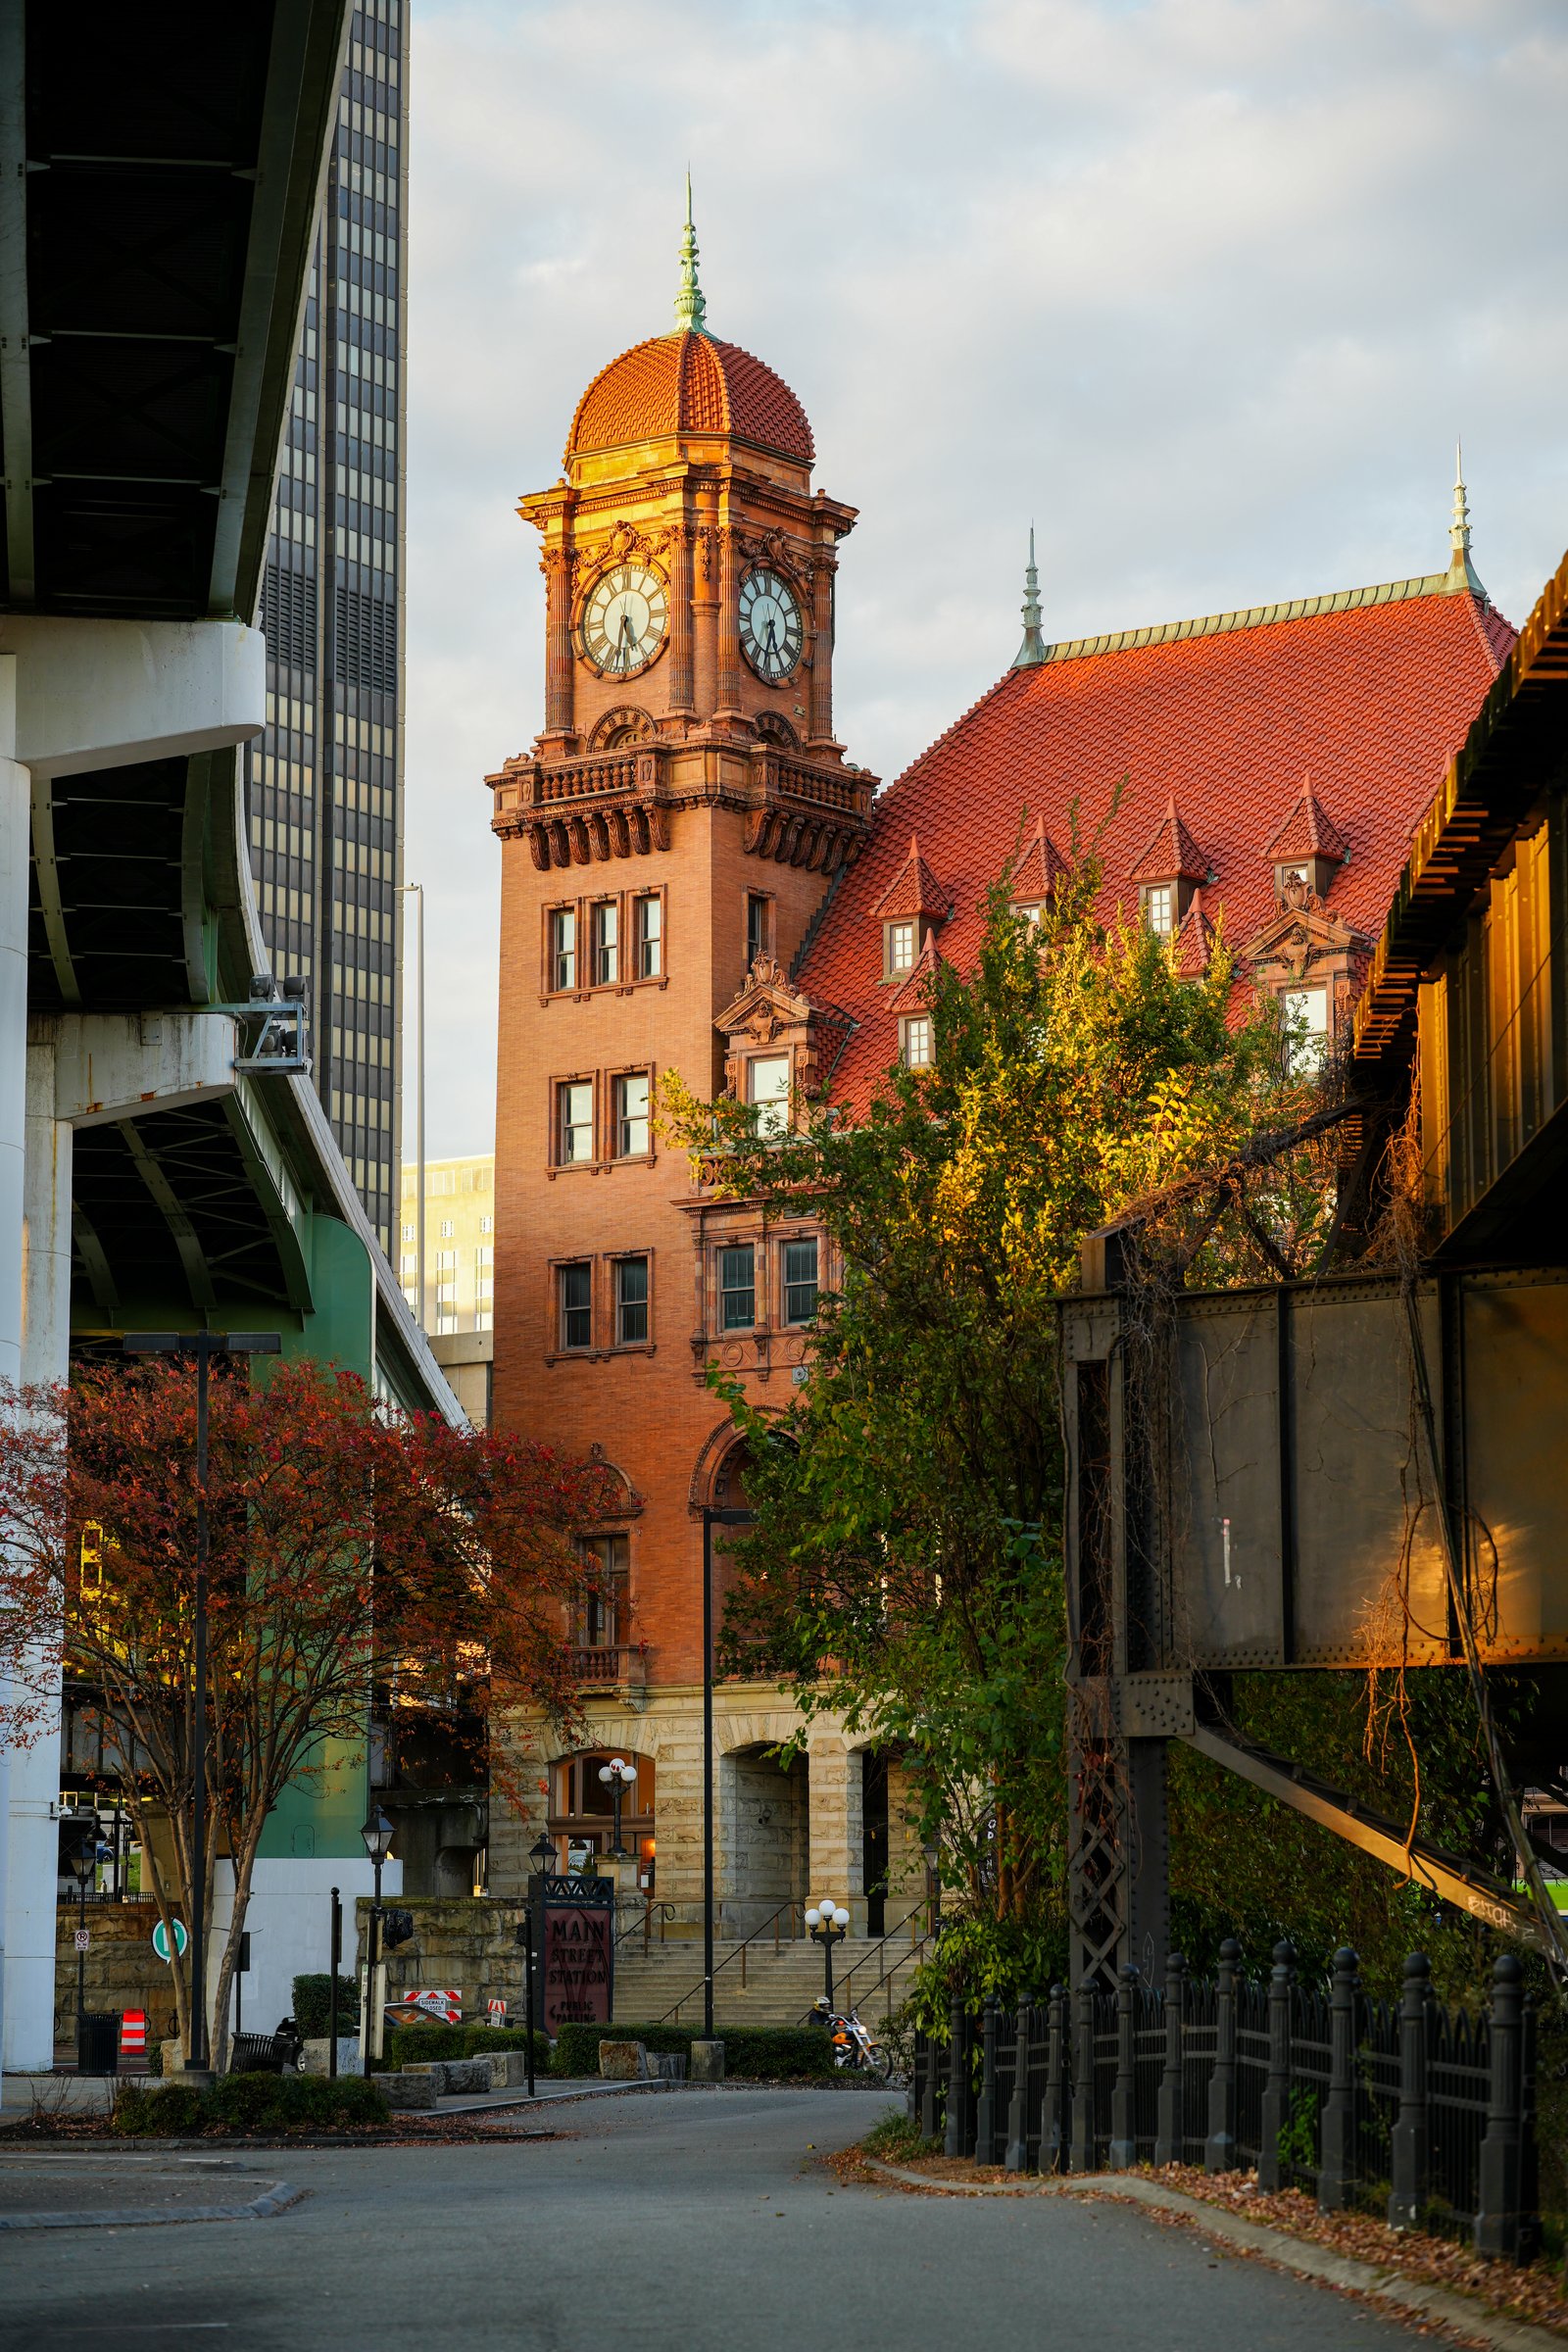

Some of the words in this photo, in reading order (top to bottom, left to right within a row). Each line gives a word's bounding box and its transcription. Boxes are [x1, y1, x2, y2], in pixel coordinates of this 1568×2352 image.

[552, 1920, 605, 1941] MAIN
[551, 1948, 605, 1963] STREET
[549, 1969, 607, 1984] STATION
[561, 2001, 594, 2011] PUBLIC
[556, 2013, 596, 2024] PARKING
